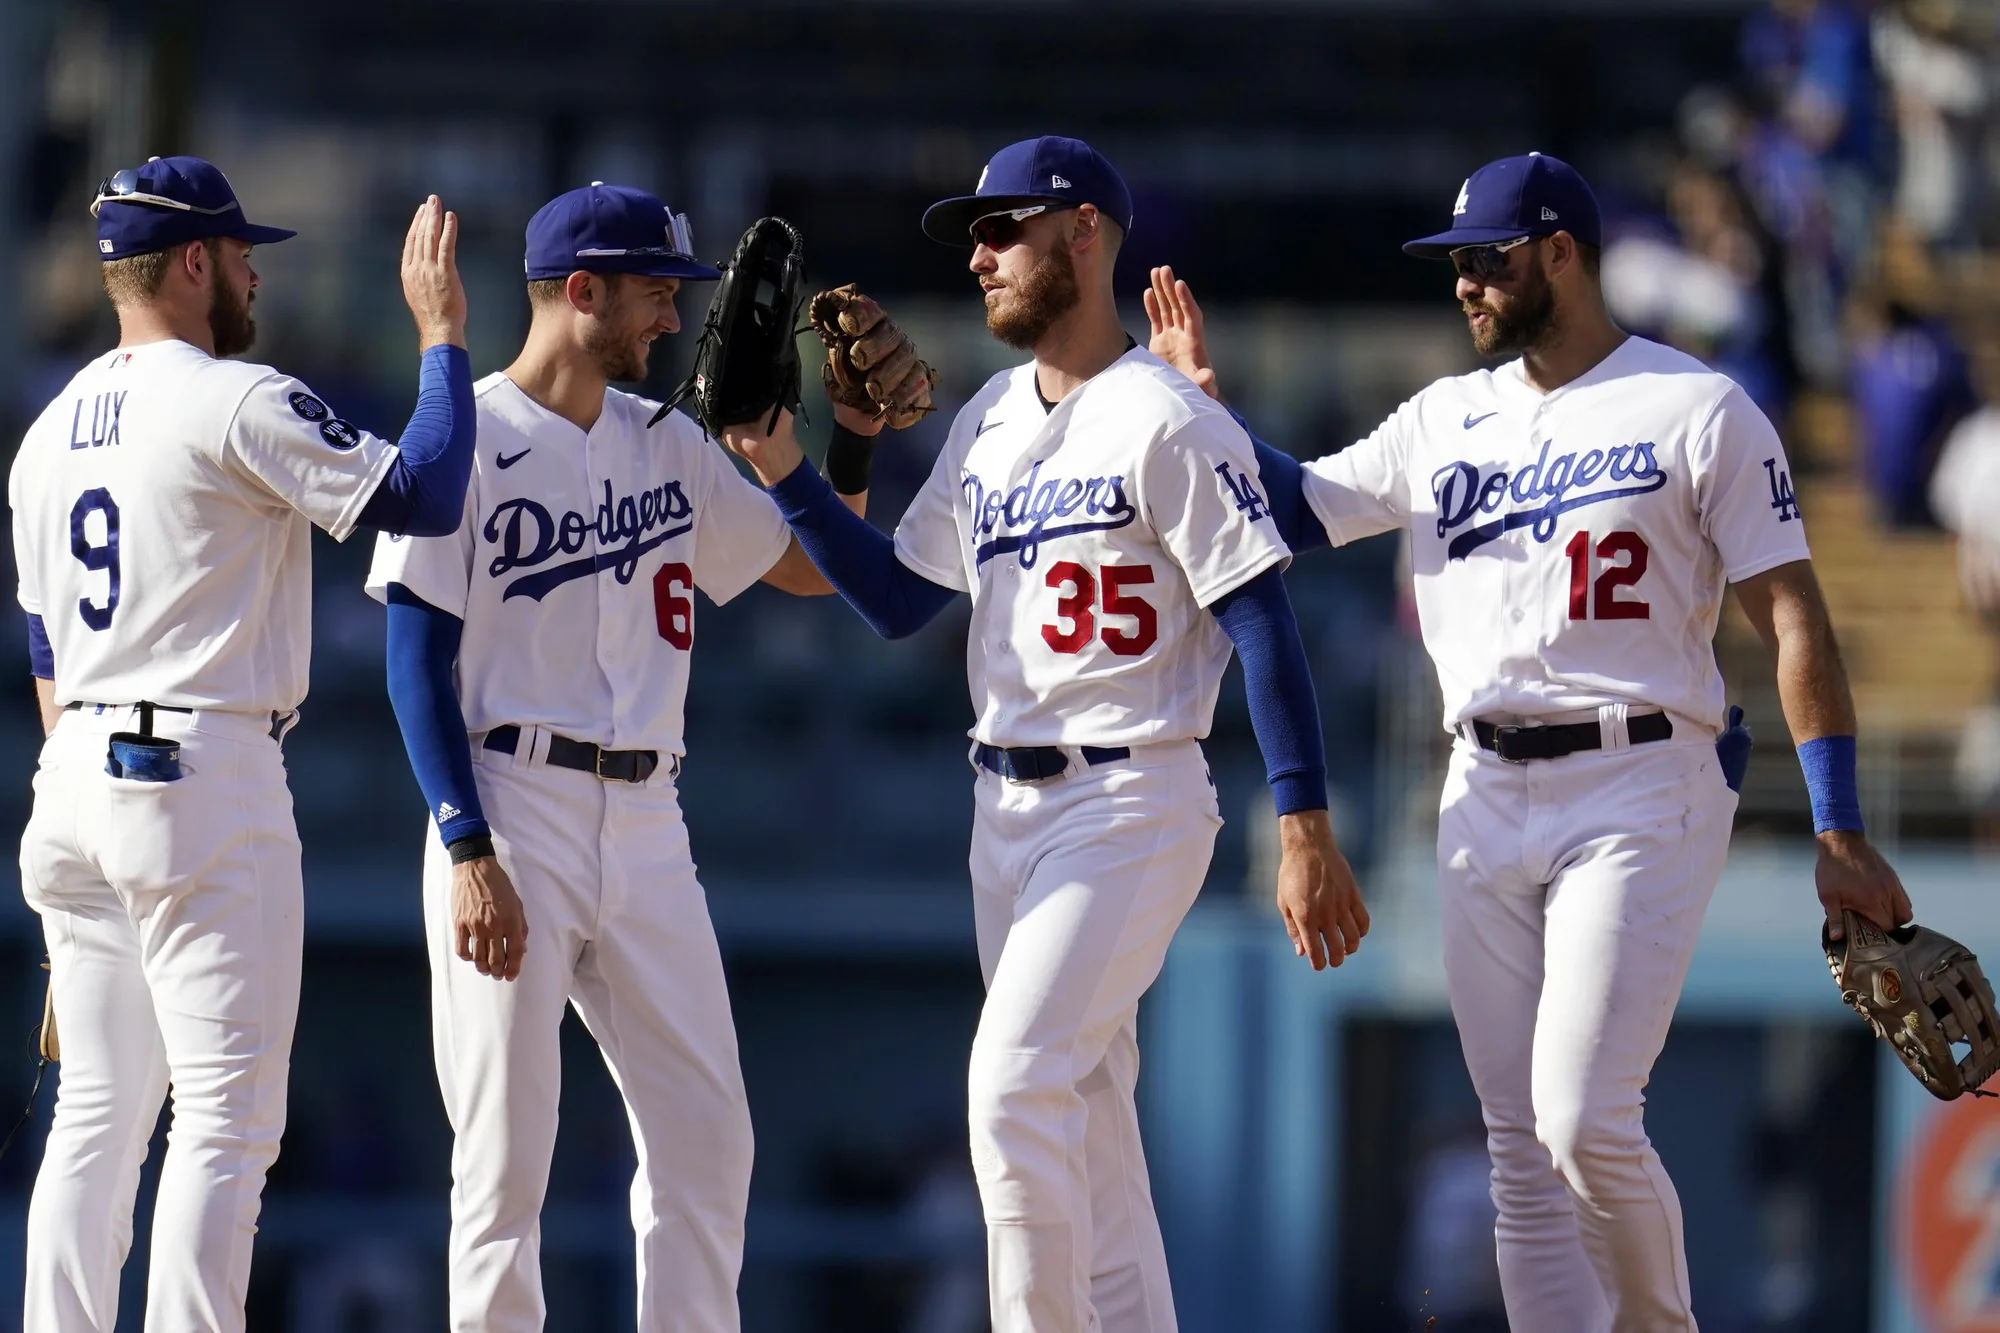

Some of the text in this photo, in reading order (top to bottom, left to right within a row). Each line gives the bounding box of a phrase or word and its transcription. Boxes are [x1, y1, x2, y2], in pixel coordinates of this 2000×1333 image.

[70, 390, 129, 450] LUX
[323, 421, 345, 437] VIN
[483, 479, 693, 585] Dodgers
[962, 460, 1136, 571] Dodgers
[1214, 461, 1271, 523] LA
[1431, 438, 1668, 545] Dodgers
[1763, 457, 1801, 522] LA
[70, 487, 121, 632] 9
[1565, 530, 1650, 620] 12
[653, 562, 693, 651] 6
[1041, 560, 1158, 656] 35
[438, 809, 461, 823] adidas
